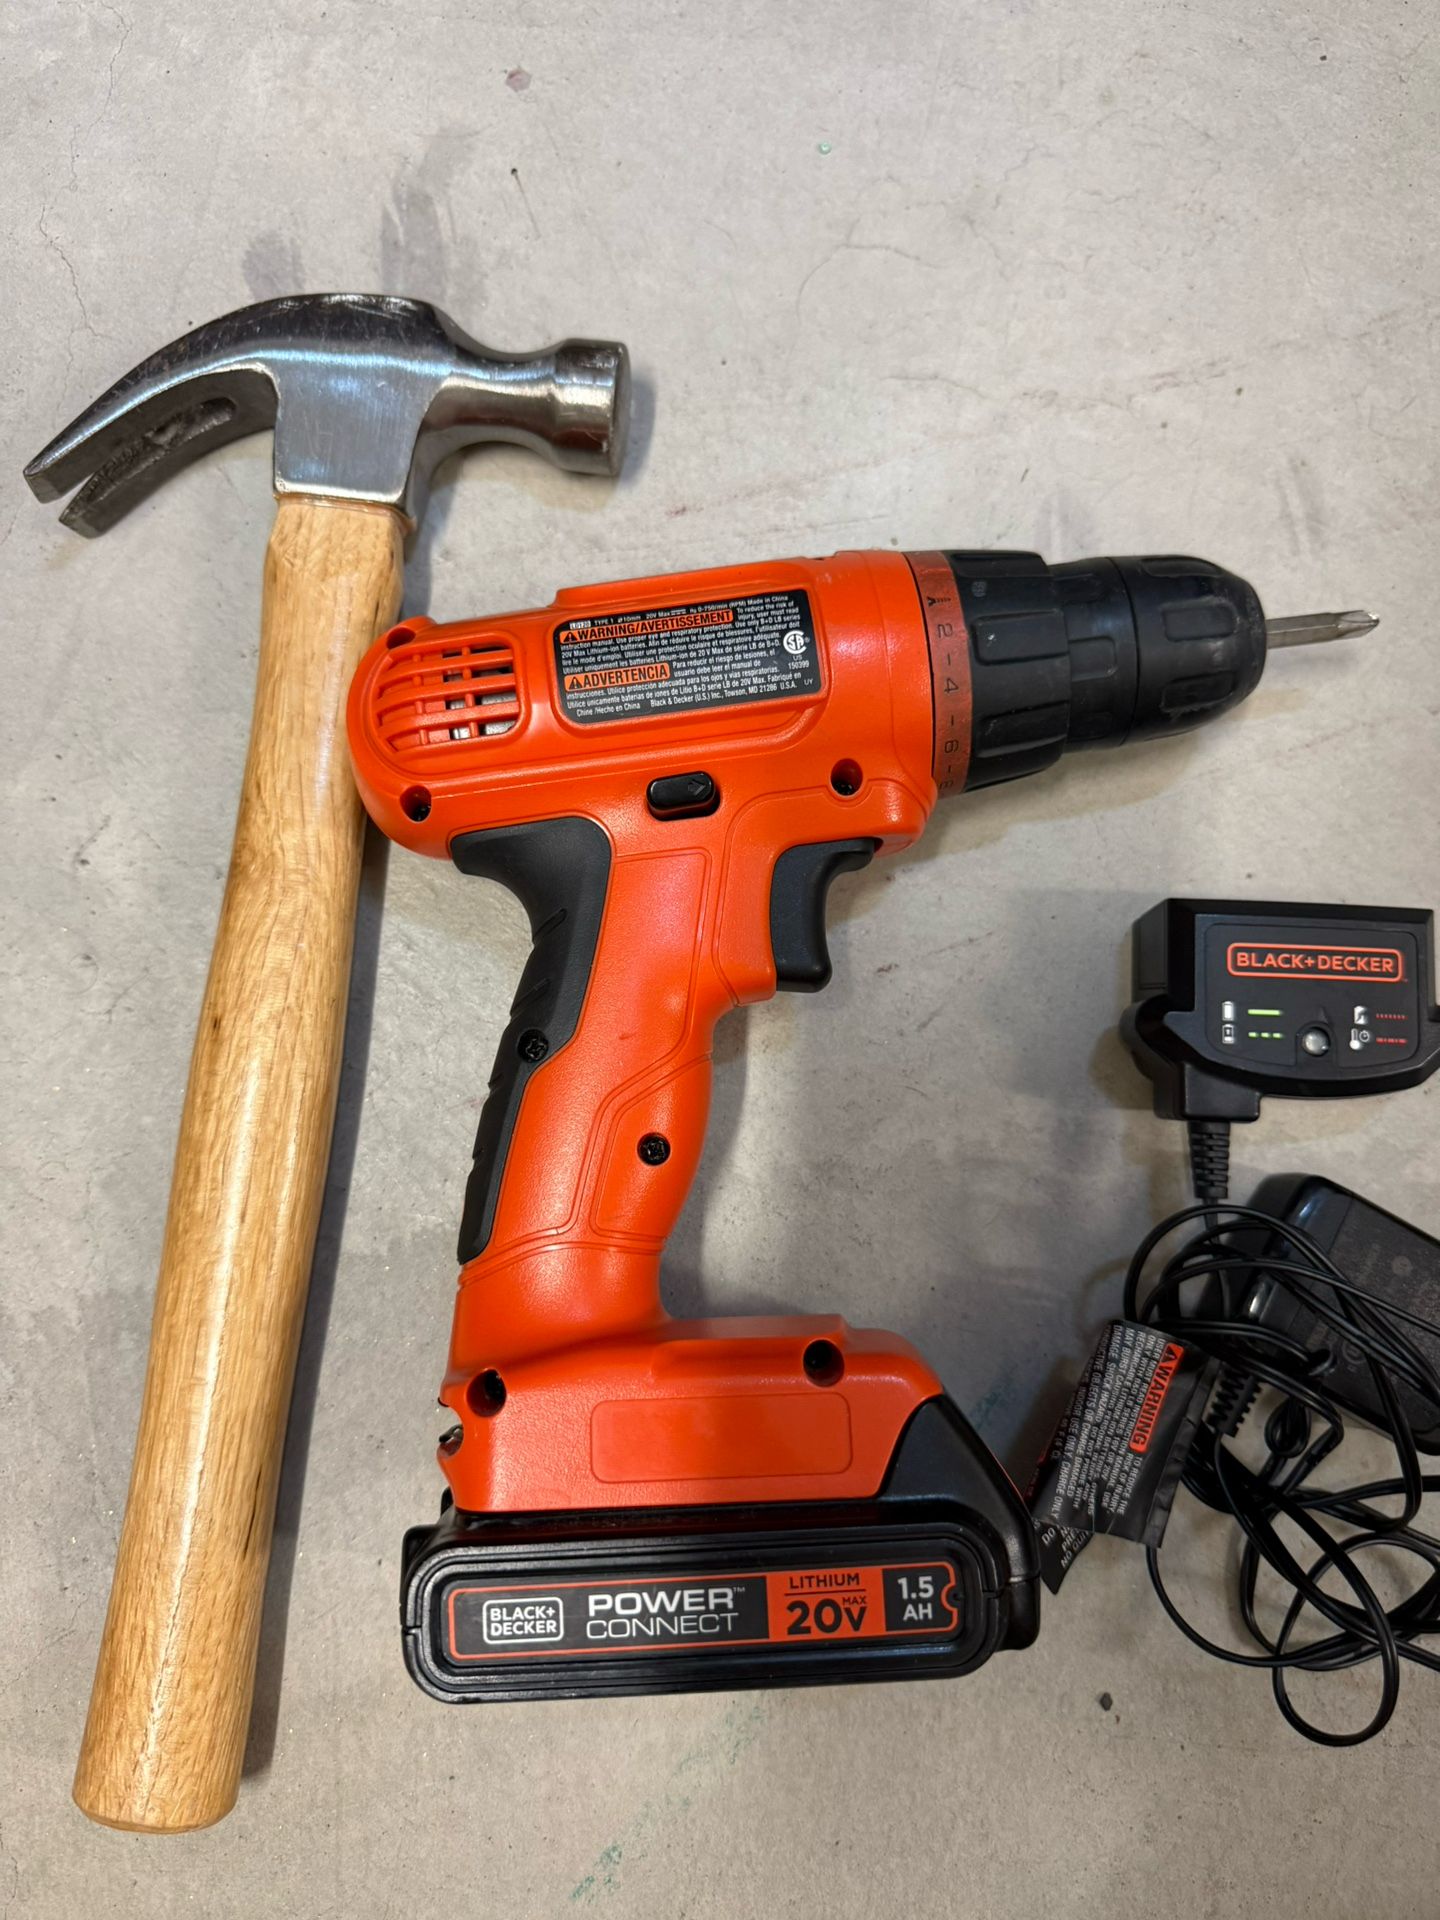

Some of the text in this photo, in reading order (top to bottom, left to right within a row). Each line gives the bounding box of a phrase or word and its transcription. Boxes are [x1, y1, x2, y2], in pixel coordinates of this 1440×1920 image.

[744, 604, 764, 613] reduce
[770, 608, 784, 616] must
[785, 606, 799, 614] read
[560, 642, 591, 652] instruction
[627, 634, 646, 642] proper
[671, 627, 701, 637] respiratory
[783, 613, 800, 621] series
[573, 649, 585, 657] Max
[697, 632, 714, 640] risque
[788, 620, 800, 628] doit
[578, 610, 731, 640] WARNING/AVERTISSEMENT
[562, 659, 572, 667] lire
[579, 656, 595, 664] mode
[624, 650, 644, 658] Utiliser
[658, 644, 687, 654] protection
[687, 641, 711, 650] oculaire
[718, 635, 752, 645] respiratoire
[563, 666, 583, 674] Utiliser
[584, 661, 619, 671] uniquement
[629, 657, 655, 666] batteries
[711, 647, 724, 655] Max
[672, 660, 686, 669] Para
[686, 657, 707, 667] reducir
[708, 656, 715, 664] el
[715, 654, 733, 663] riesgo
[769, 648, 775, 656] el
[582, 664, 668, 687] ADVERTENCIA
[674, 659, 761, 677] usuario debe leer el manual de
[567, 700, 585, 709] Utilice
[645, 691, 653, 699] de
[654, 689, 670, 697] iones
[679, 686, 692, 694] Litio
[731, 679, 739, 687] de
[740, 678, 751, 686] 20V
[794, 671, 801, 679] en
[607, 686, 625, 695] Utilice
[658, 678, 686, 688] adecuada
[686, 676, 700, 684] para
[710, 673, 723, 681] ojos
[943, 677, 960, 693] 4
[576, 708, 593, 717] Chine
[615, 704, 623, 712] en
[624, 702, 641, 711] China
[650, 699, 666, 707] Black
[673, 695, 694, 705] Decker
[748, 686, 758, 694] MD
[943, 738, 960, 754] 6
[1236, 952, 1395, 973] BLACK+DECKER
[1122, 1327, 1135, 1346] MAY
[1102, 1361, 1116, 1390] SHOCK
[1116, 1346, 1131, 1376] BURST
[1085, 1371, 1101, 1408] OBJECTS
[1106, 1334, 1157, 1463] ONLY WITH SERIES OR
[1107, 1374, 1124, 1409] CAUSING
[1083, 1408, 1094, 1421] OR
[1132, 1366, 1171, 1446] WARNING
[1067, 1417, 1079, 1434] USE
[1100, 1337, 1166, 1508] USER MUST READ INSTRUCTION USE
[1075, 1422, 1091, 1457] CHARGE
[1055, 1460, 1070, 1495] CHARGE
[1065, 1456, 1083, 1497] DAMAGED
[1117, 1453, 1134, 1483] RISK OF
[1116, 1456, 1143, 1515] TO REDUCE THE
[1049, 1495, 1063, 1519] ONLY
[1041, 1527, 1056, 1546] DO
[788, 1571, 861, 1590] LITHIUM
[896, 1575, 935, 1600] 1.5
[489, 1603, 556, 1622] BLACK+
[587, 1588, 735, 1618] POWER
[786, 1596, 868, 1636] 20V MAX
[902, 1602, 934, 1623] AH
[489, 1618, 558, 1637] DECKER
[585, 1611, 740, 1640] CONNECT
